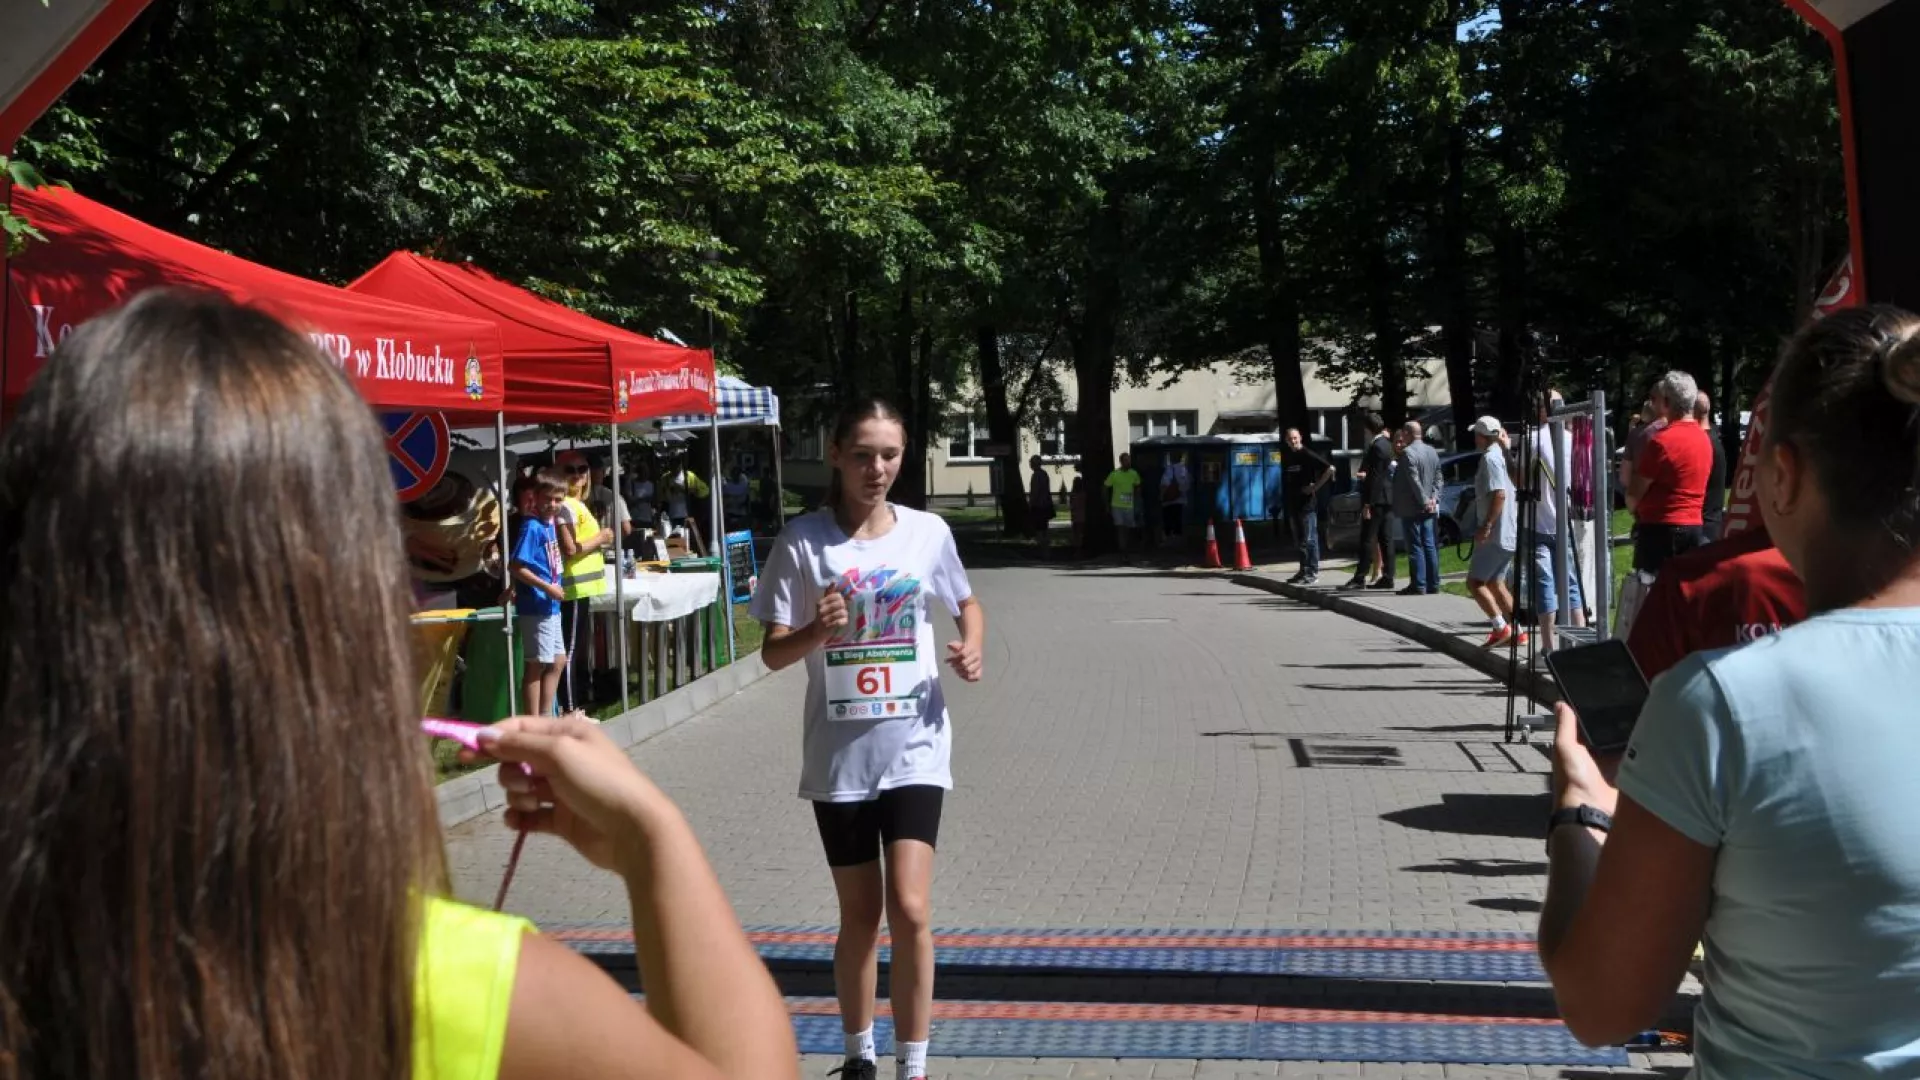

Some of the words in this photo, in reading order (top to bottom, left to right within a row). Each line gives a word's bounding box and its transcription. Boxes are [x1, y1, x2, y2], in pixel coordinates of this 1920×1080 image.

[355, 348, 372, 377] w
[375, 336, 455, 384] Kłobucku
[856, 666, 891, 695] 61
